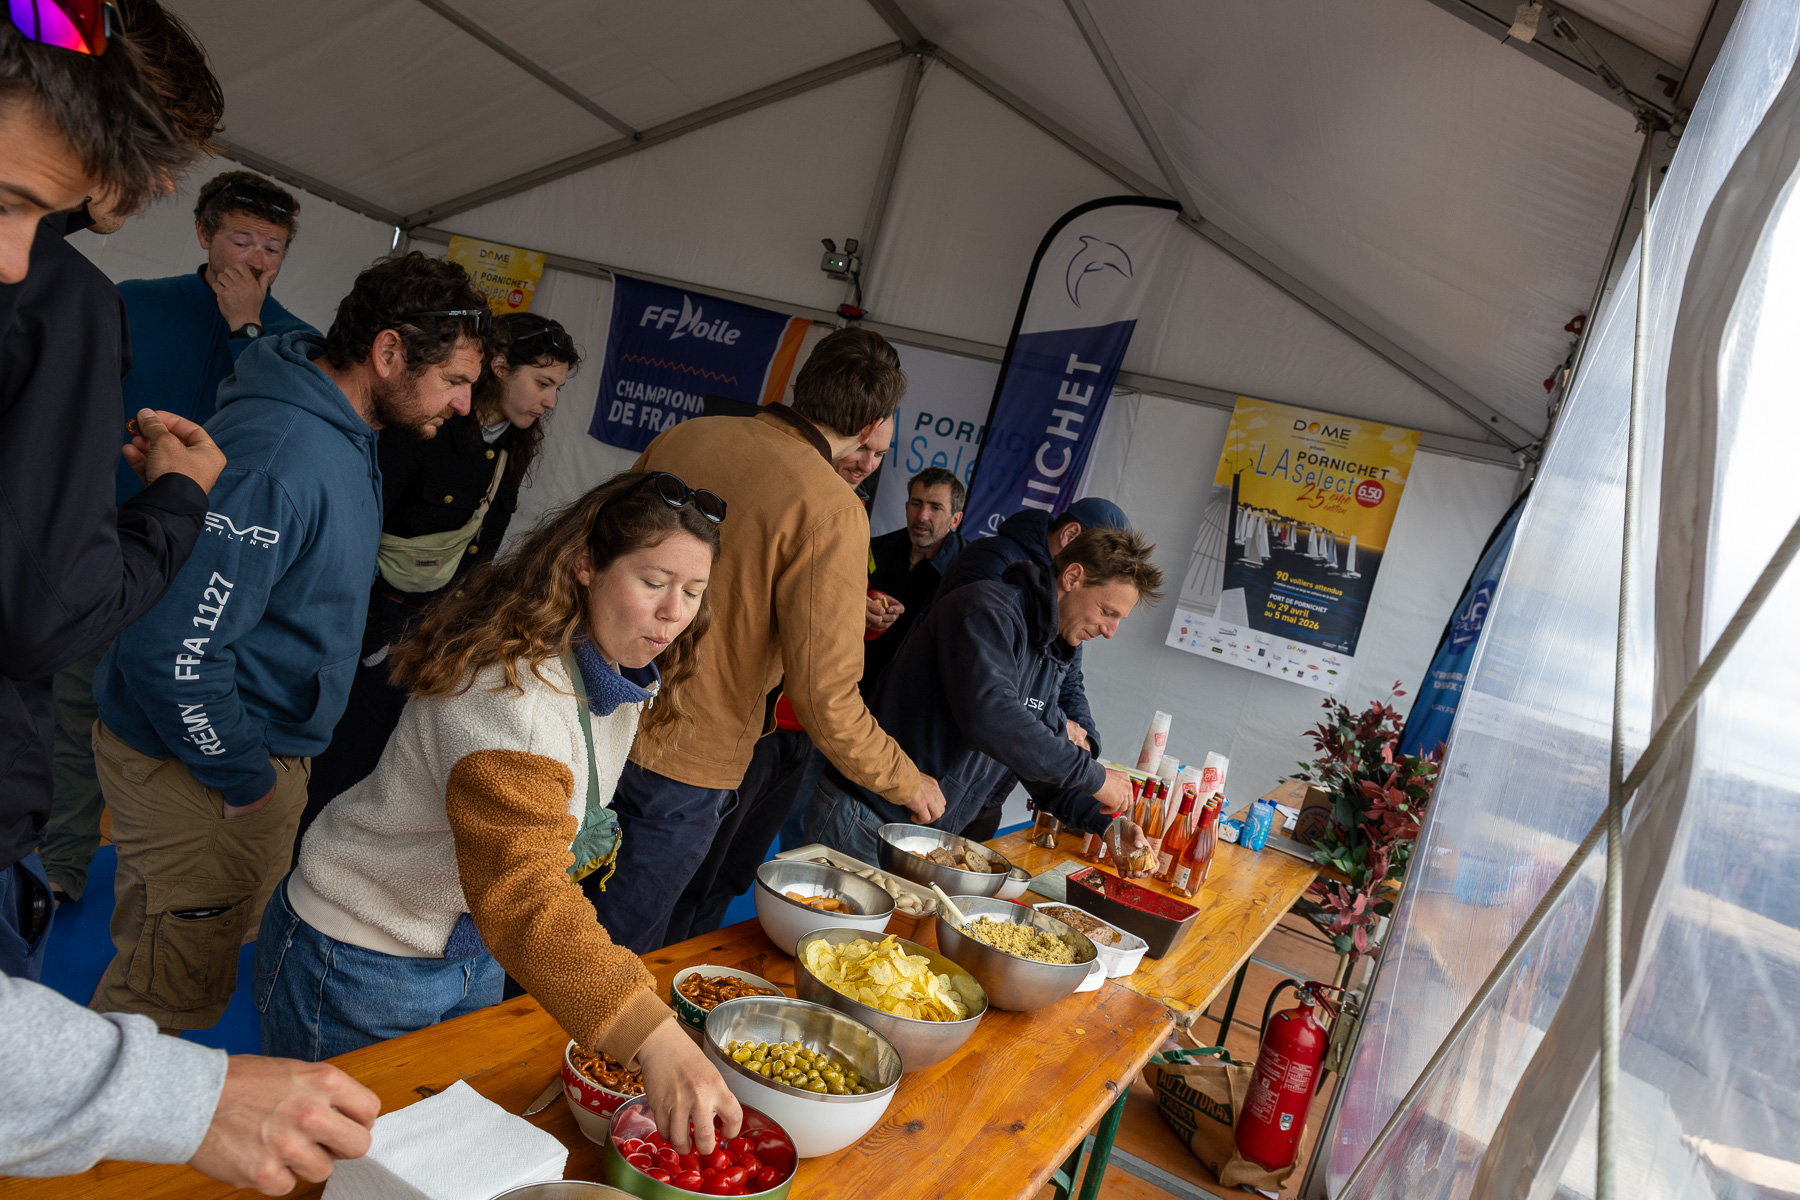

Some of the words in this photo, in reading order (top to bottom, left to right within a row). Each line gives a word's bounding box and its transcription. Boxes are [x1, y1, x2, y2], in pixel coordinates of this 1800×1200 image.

[480, 249, 510, 263] DOME
[481, 272, 528, 289] PORNICHET
[639, 294, 741, 345] FFVoile
[607, 400, 636, 426] DE
[638, 406, 688, 433] FRA
[1293, 419, 1352, 441] DOME
[1296, 451, 1390, 480] PORNICHET
[1296, 483, 1331, 509] 25
[1358, 485, 1383, 500] 6.50
[205, 526, 270, 549] AILING
[1276, 570, 1289, 582] 90
[1290, 576, 1313, 588] voiliers
[1314, 583, 1343, 596] attendus
[193, 571, 234, 631] 1127
[1267, 601, 1276, 609] Du
[1278, 602, 1289, 612] 29
[1290, 607, 1309, 618] avril
[1269, 593, 1284, 603] PORT
[1285, 597, 1294, 606] DE
[1295, 599, 1327, 614] PORNICHET
[1274, 612, 1280, 620] 5
[1281, 614, 1297, 624] mai
[1298, 617, 1319, 630] 2026
[178, 703, 226, 756] RÉMY
[1158, 1069, 1177, 1090] AU
[1177, 1079, 1231, 1122] LITTORAL
